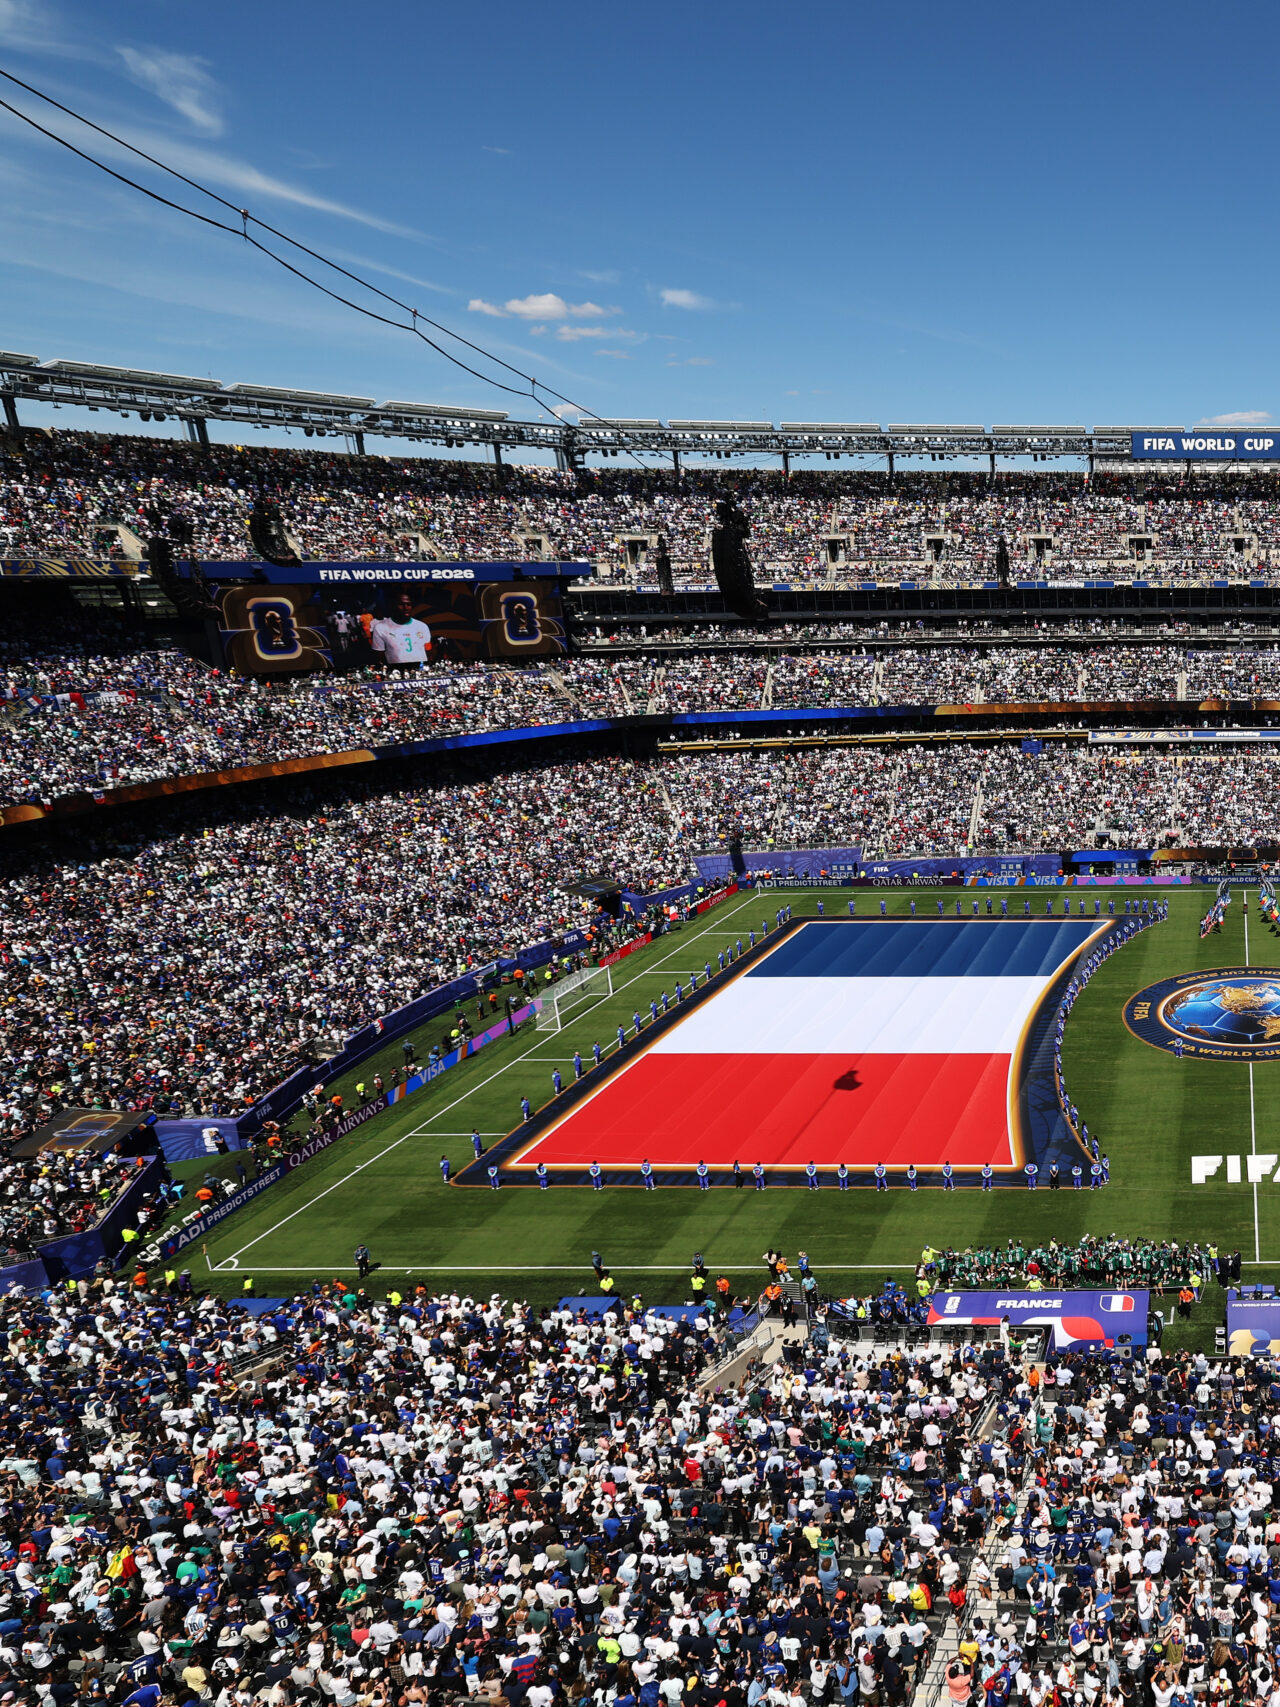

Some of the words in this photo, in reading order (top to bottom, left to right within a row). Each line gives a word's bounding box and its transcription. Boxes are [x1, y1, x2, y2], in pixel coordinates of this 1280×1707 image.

[1143, 438, 1176, 451] FIFA
[1181, 438, 1235, 451] WORLD
[1244, 438, 1274, 451] CUP
[319, 569, 351, 580] FIFA
[351, 569, 401, 580] WORLD
[404, 569, 430, 579] CUP
[431, 569, 475, 579] 2026
[405, 637, 413, 652] 3
[754, 880, 777, 888] ADI
[778, 879, 843, 887] PREDICTSTREET
[872, 878, 903, 887] QATAR
[905, 878, 944, 886] AIRWAYS
[986, 876, 1009, 886] VISA
[1034, 876, 1057, 886] VISA
[708, 891, 728, 907] Lenovo
[563, 934, 579, 945] FIFA
[1133, 1001, 1151, 1021] FIFA
[1167, 1040, 1196, 1052] FFA
[1199, 1047, 1251, 1057] WORLD
[418, 1059, 446, 1084] VISA
[255, 1103, 273, 1120] FIFA
[289, 1133, 333, 1167] QATAR
[336, 1097, 385, 1138] AIRWAYS
[178, 1220, 206, 1248] ADI
[207, 1167, 281, 1226] PREDICTSTREET
[995, 1299, 1063, 1309] FRANCE
[1067, 1541, 1073, 1551] 7
[758, 1550, 768, 1560] 10
[275, 1618, 288, 1629] 10
